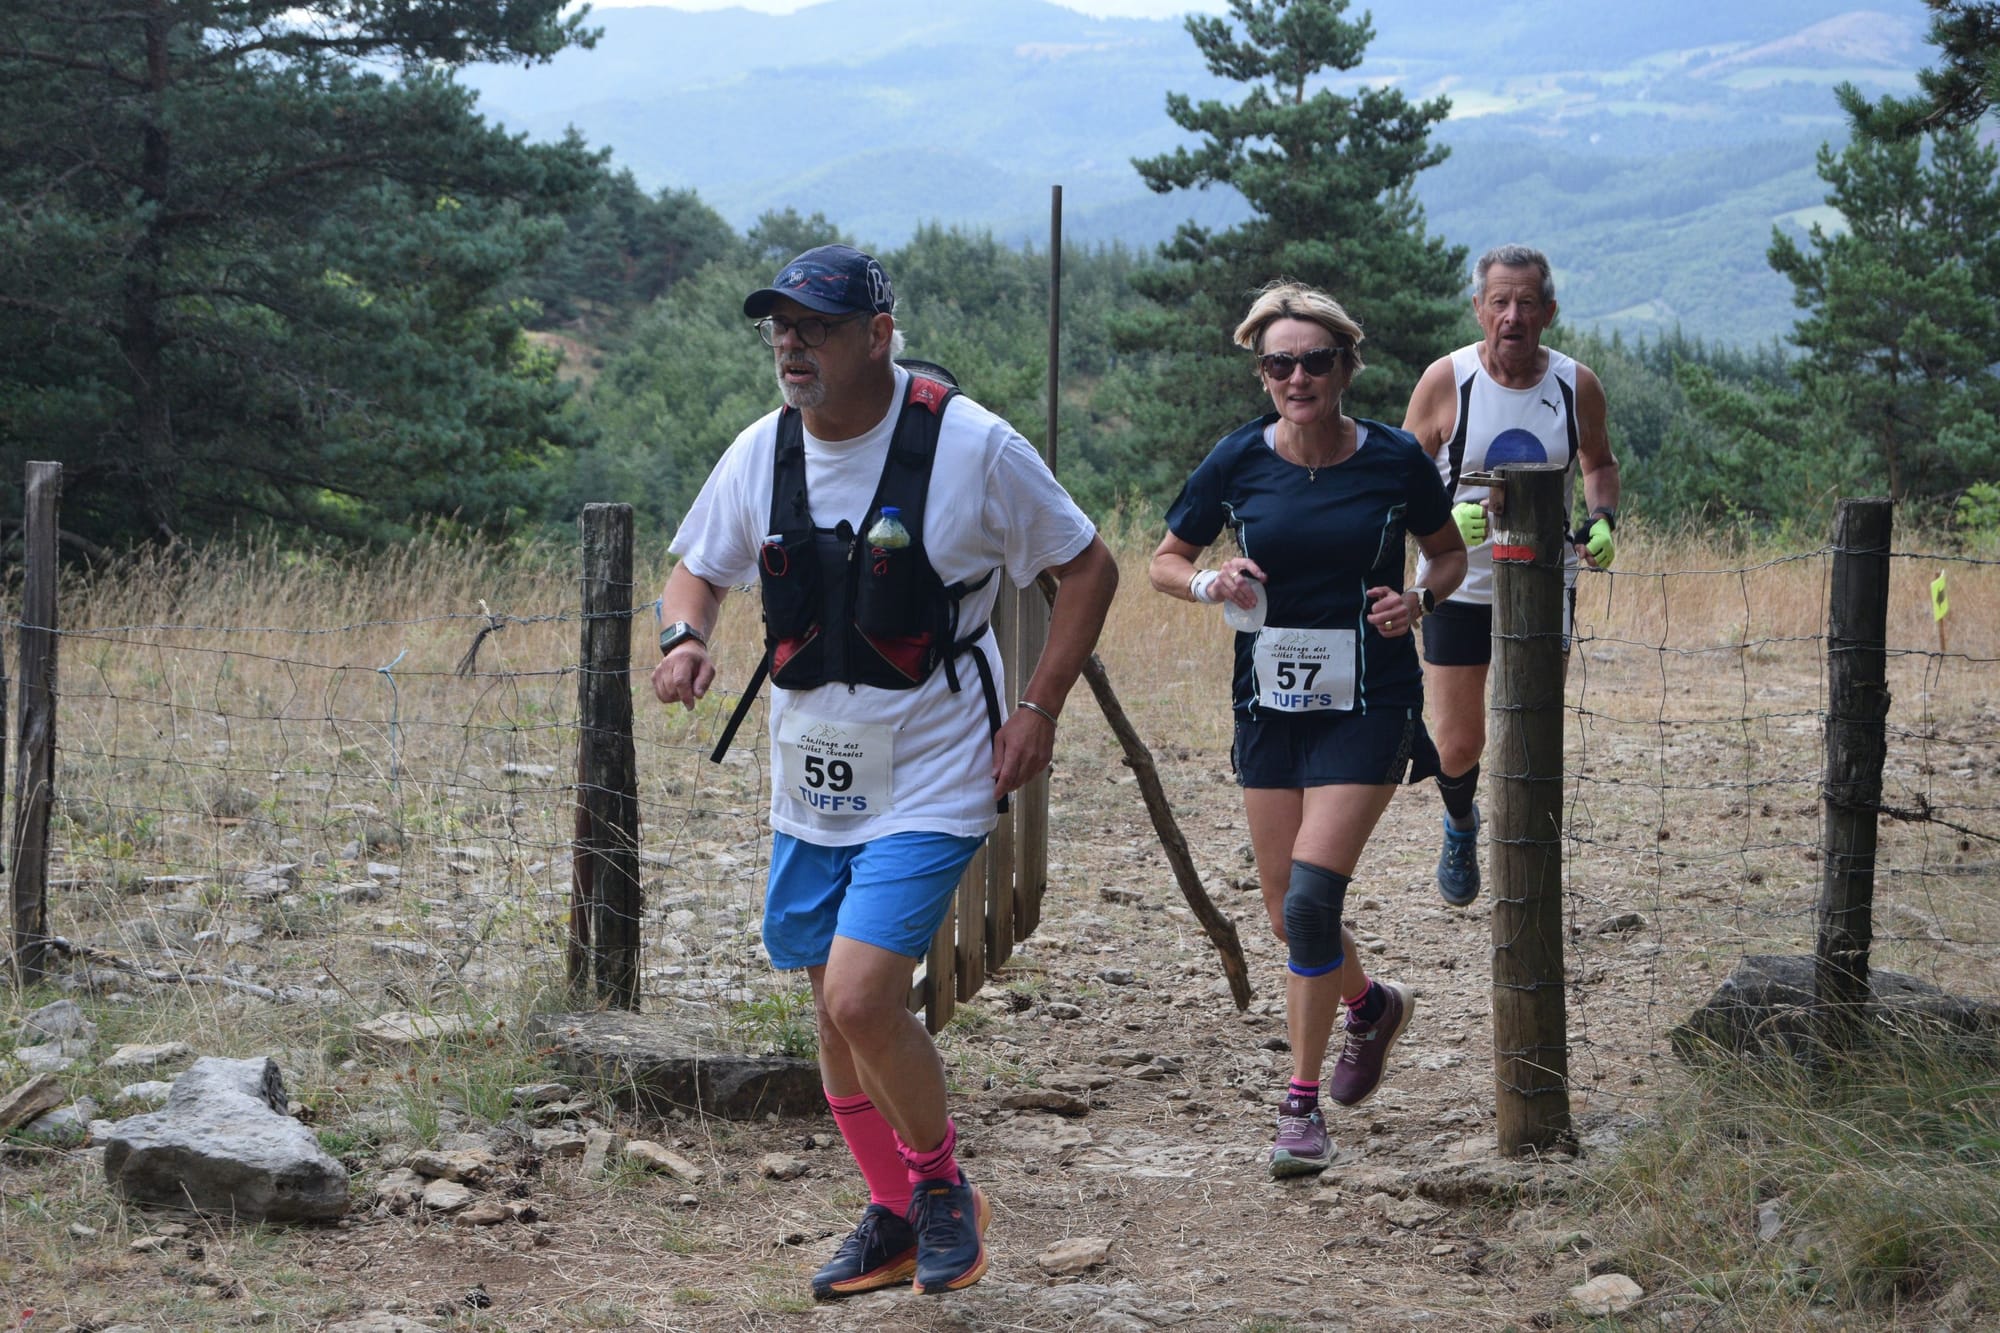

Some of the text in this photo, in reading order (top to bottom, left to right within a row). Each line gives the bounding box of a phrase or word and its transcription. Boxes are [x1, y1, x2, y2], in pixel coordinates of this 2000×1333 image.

[1274, 645, 1327, 653] Challenge des
[1277, 661, 1321, 690] 57
[1272, 691, 1332, 708] TUFF'S
[801, 735, 860, 750] Challenge des
[805, 755, 853, 792] 59
[799, 785, 867, 811] TUFF'S
